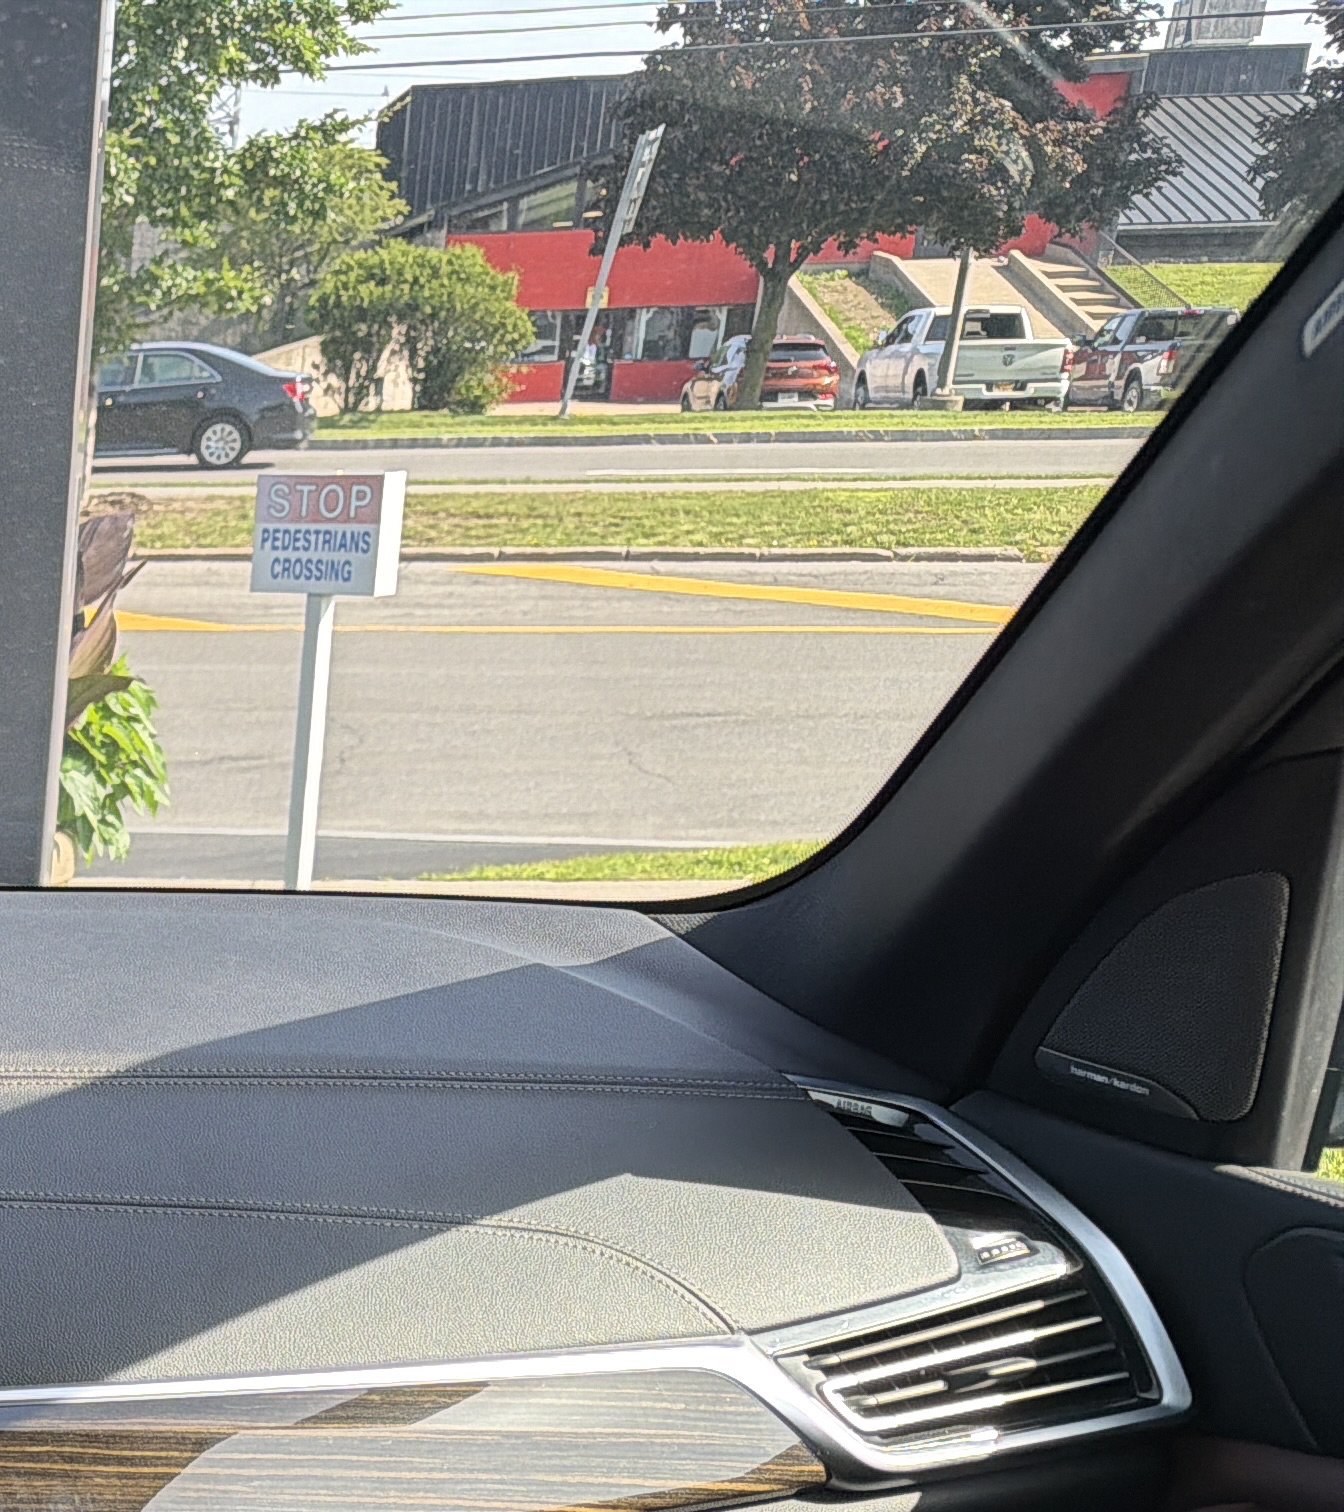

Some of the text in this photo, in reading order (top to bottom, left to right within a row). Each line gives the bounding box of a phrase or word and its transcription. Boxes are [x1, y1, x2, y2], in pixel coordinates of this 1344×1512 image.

[268, 483, 373, 519] STOP
[260, 528, 372, 554] PEDESTRIANS
[270, 557, 353, 582] CROSSING
